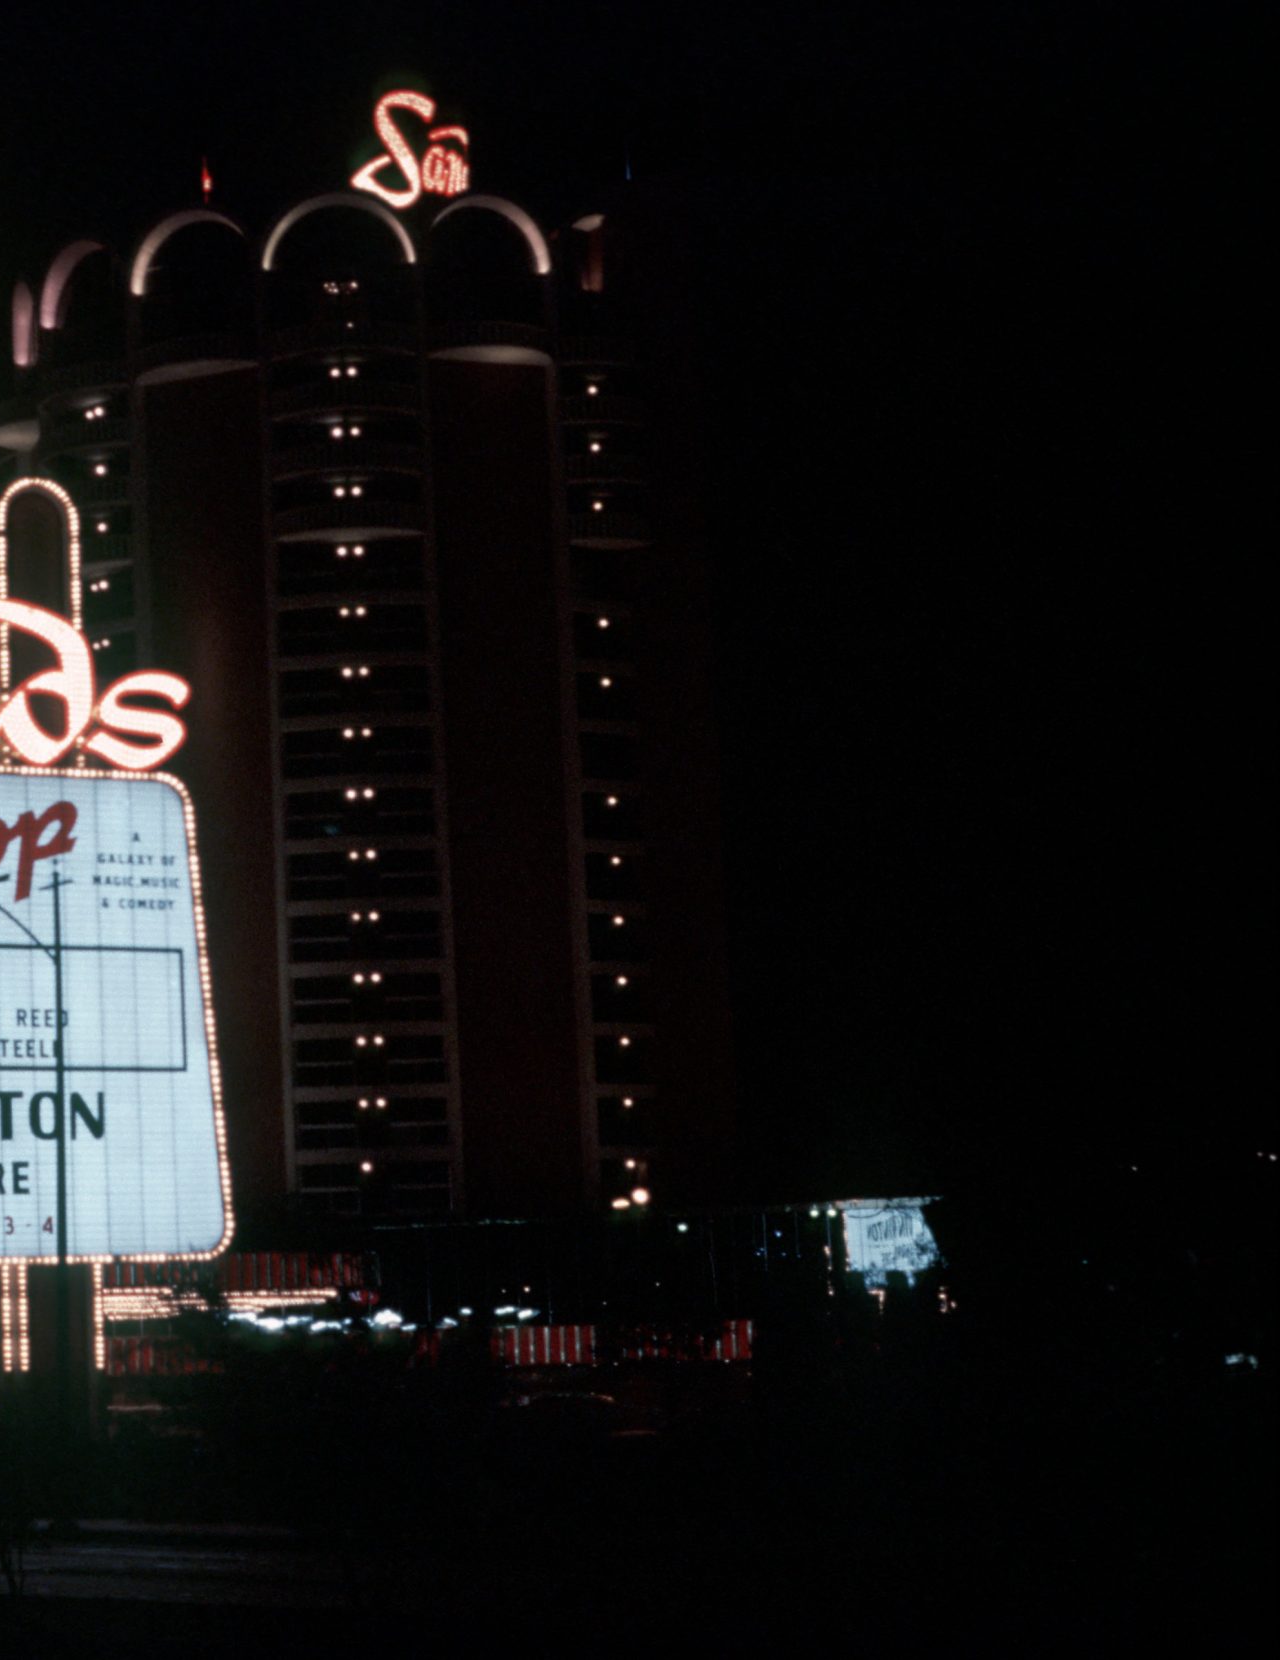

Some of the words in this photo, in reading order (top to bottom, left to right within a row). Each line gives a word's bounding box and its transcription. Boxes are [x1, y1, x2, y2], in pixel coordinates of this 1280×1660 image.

[132, 832, 140, 841] A
[97, 854, 153, 865] GALAXY
[161, 855, 175, 866] OF
[141, 878, 179, 889] MUSIC
[102, 898, 110, 908] &
[118, 899, 174, 910] COMEDY
[3, 1215, 15, 1235] 3
[42, 1215, 55, 1235] 4
